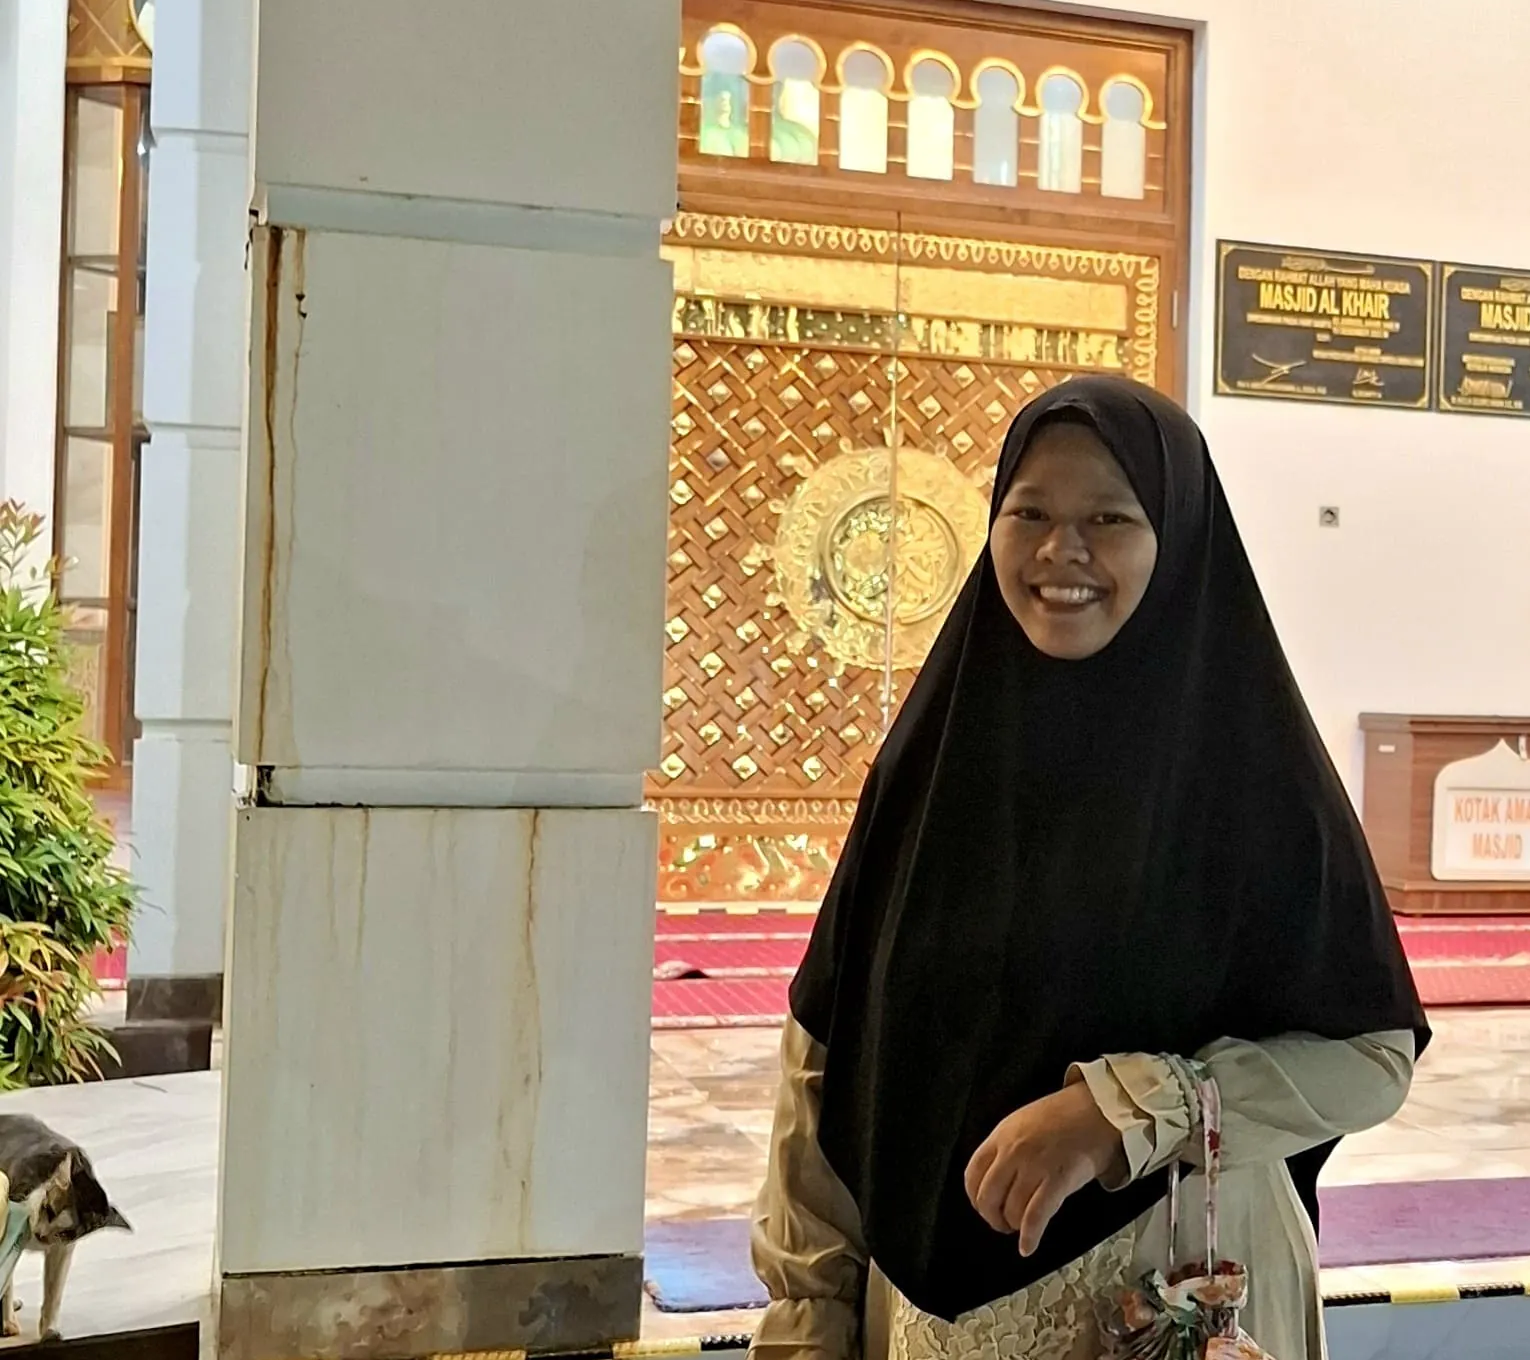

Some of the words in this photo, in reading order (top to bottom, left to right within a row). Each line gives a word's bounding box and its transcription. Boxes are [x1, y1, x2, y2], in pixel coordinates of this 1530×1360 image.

[1259, 282, 1316, 313] MASJID
[1318, 288, 1340, 315] AL
[1341, 290, 1390, 319] KHAIR
[1453, 796, 1500, 823] KOTAK
[1472, 833, 1523, 860] MASJID
